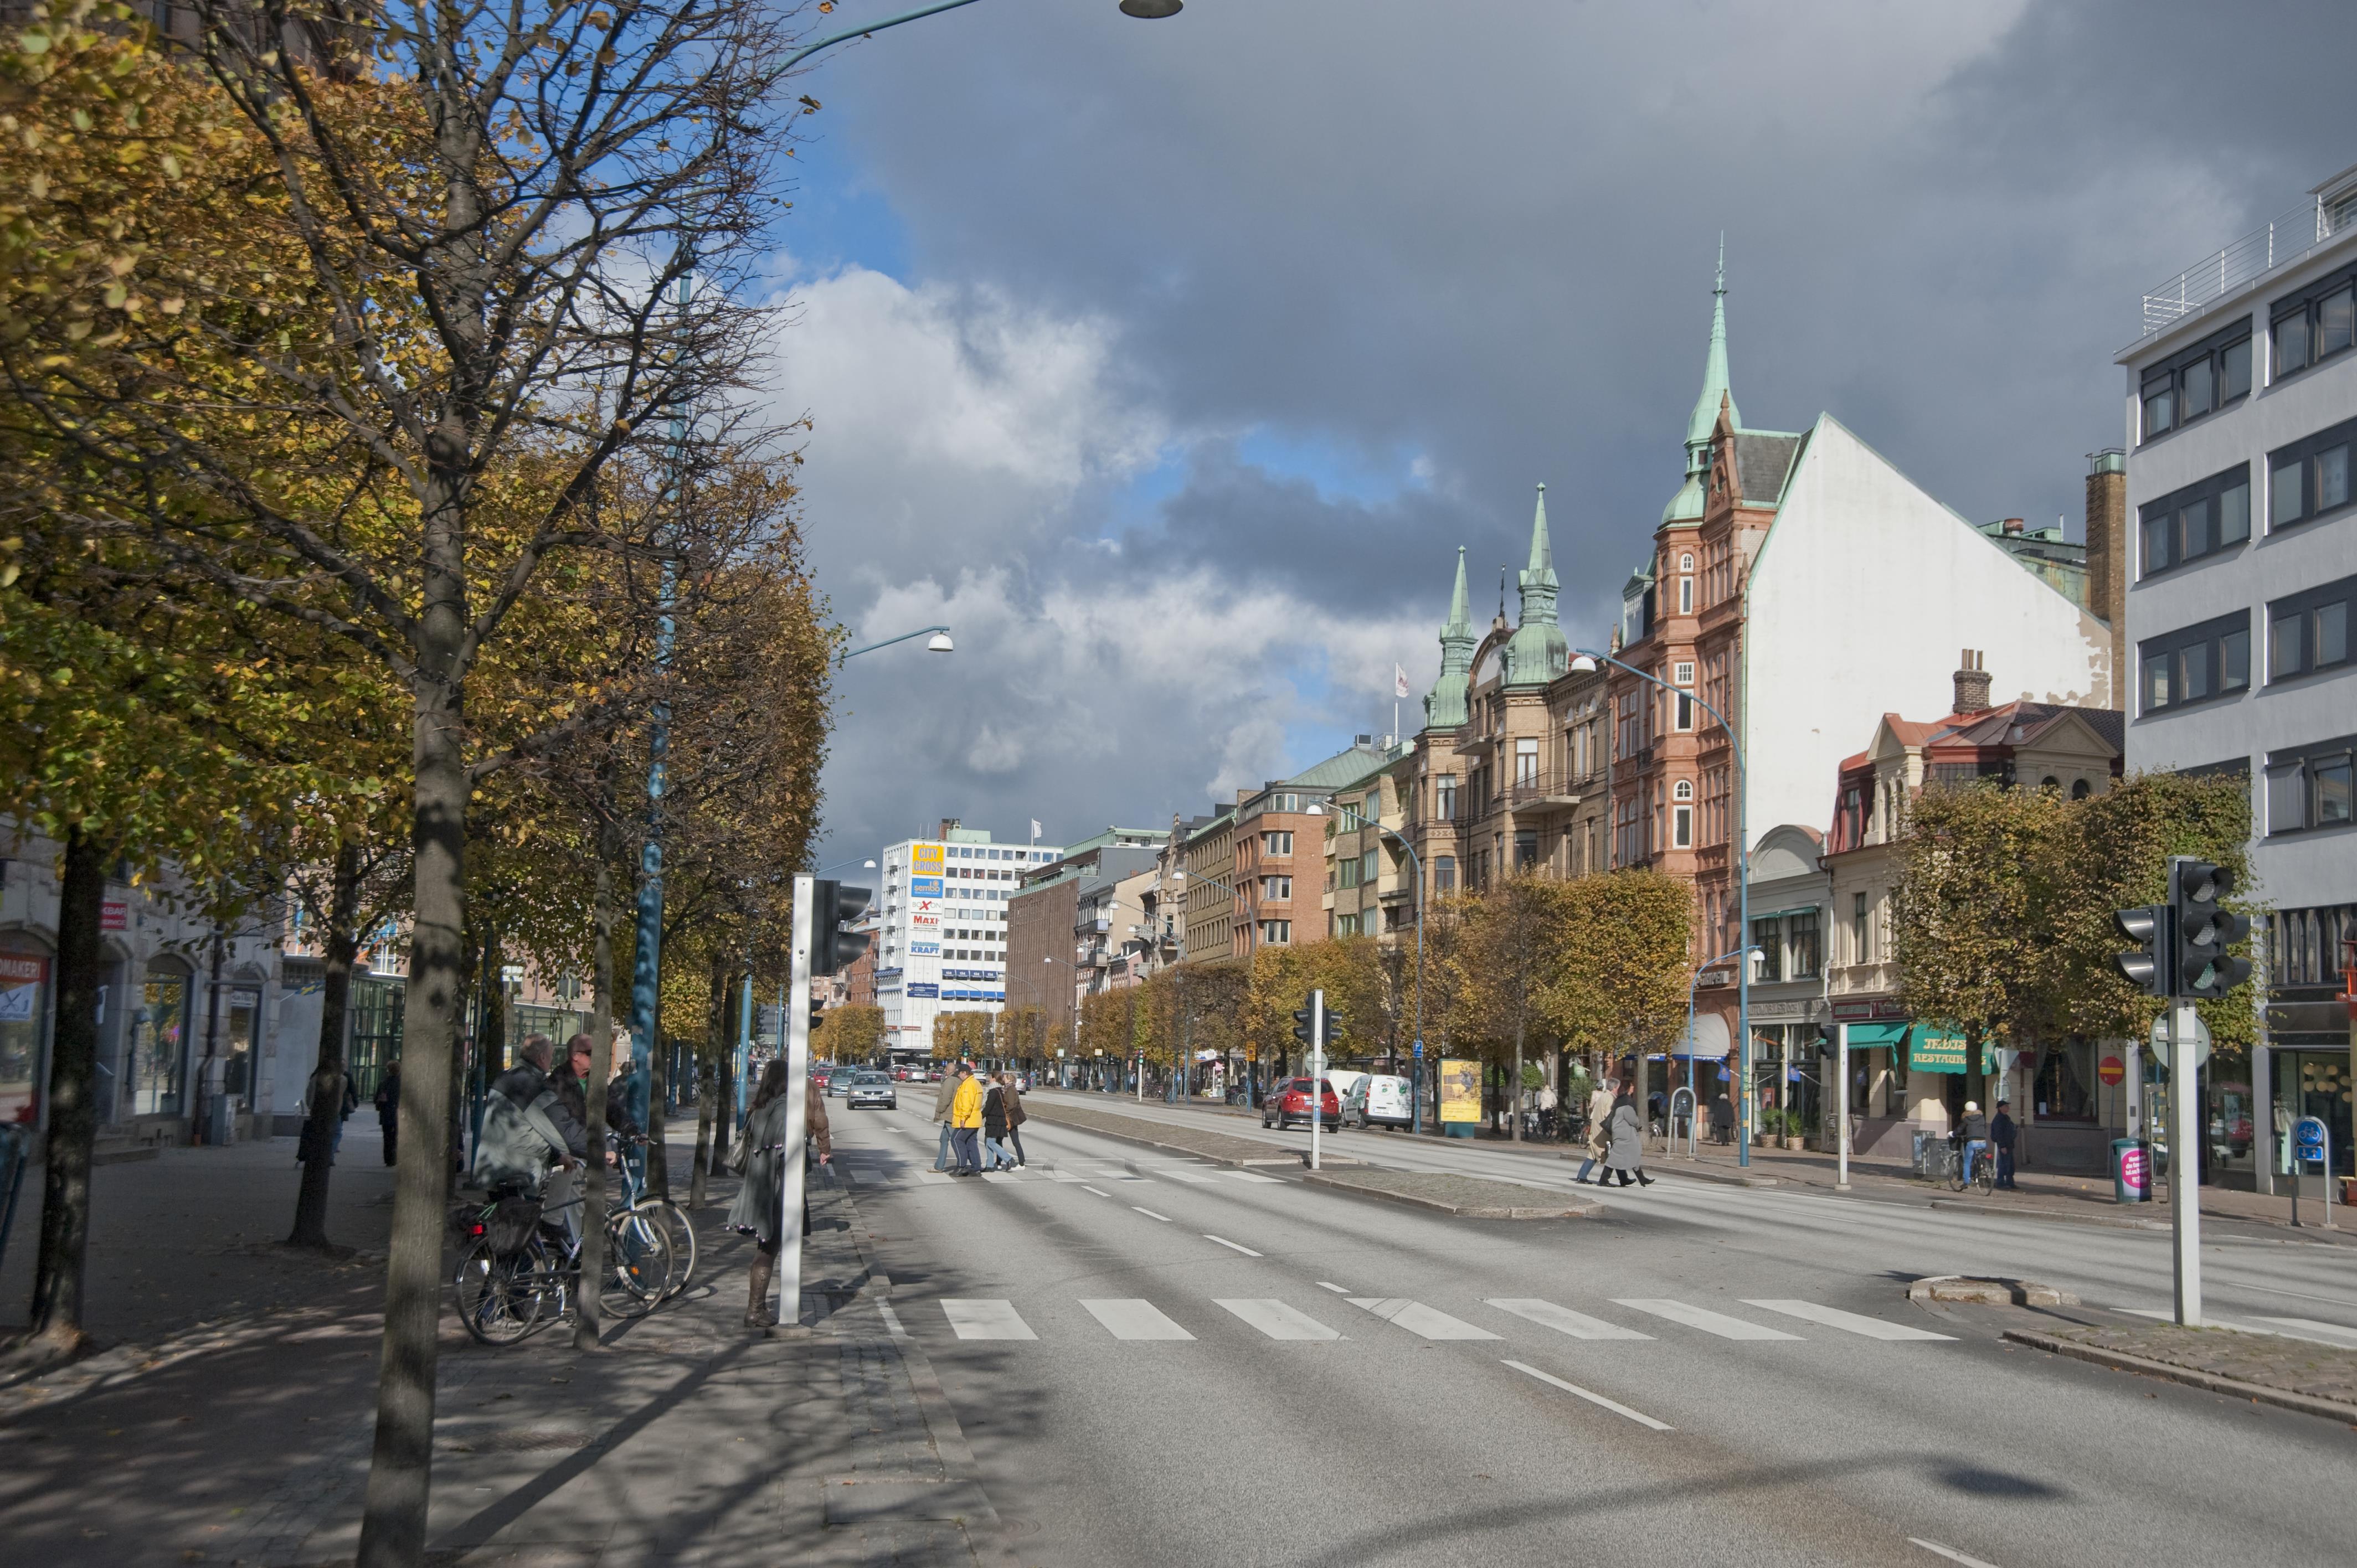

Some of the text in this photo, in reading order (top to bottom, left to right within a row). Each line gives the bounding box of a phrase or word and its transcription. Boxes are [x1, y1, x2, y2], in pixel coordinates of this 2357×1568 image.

[919, 848, 938, 859] CITY
[914, 860, 941, 872] GROSS
[912, 901, 941, 910] BOXON
[913, 915, 938, 925] MAXI
[2184, 1001, 2189, 1011] 2
[1913, 1053, 1987, 1065] RESTAURG
